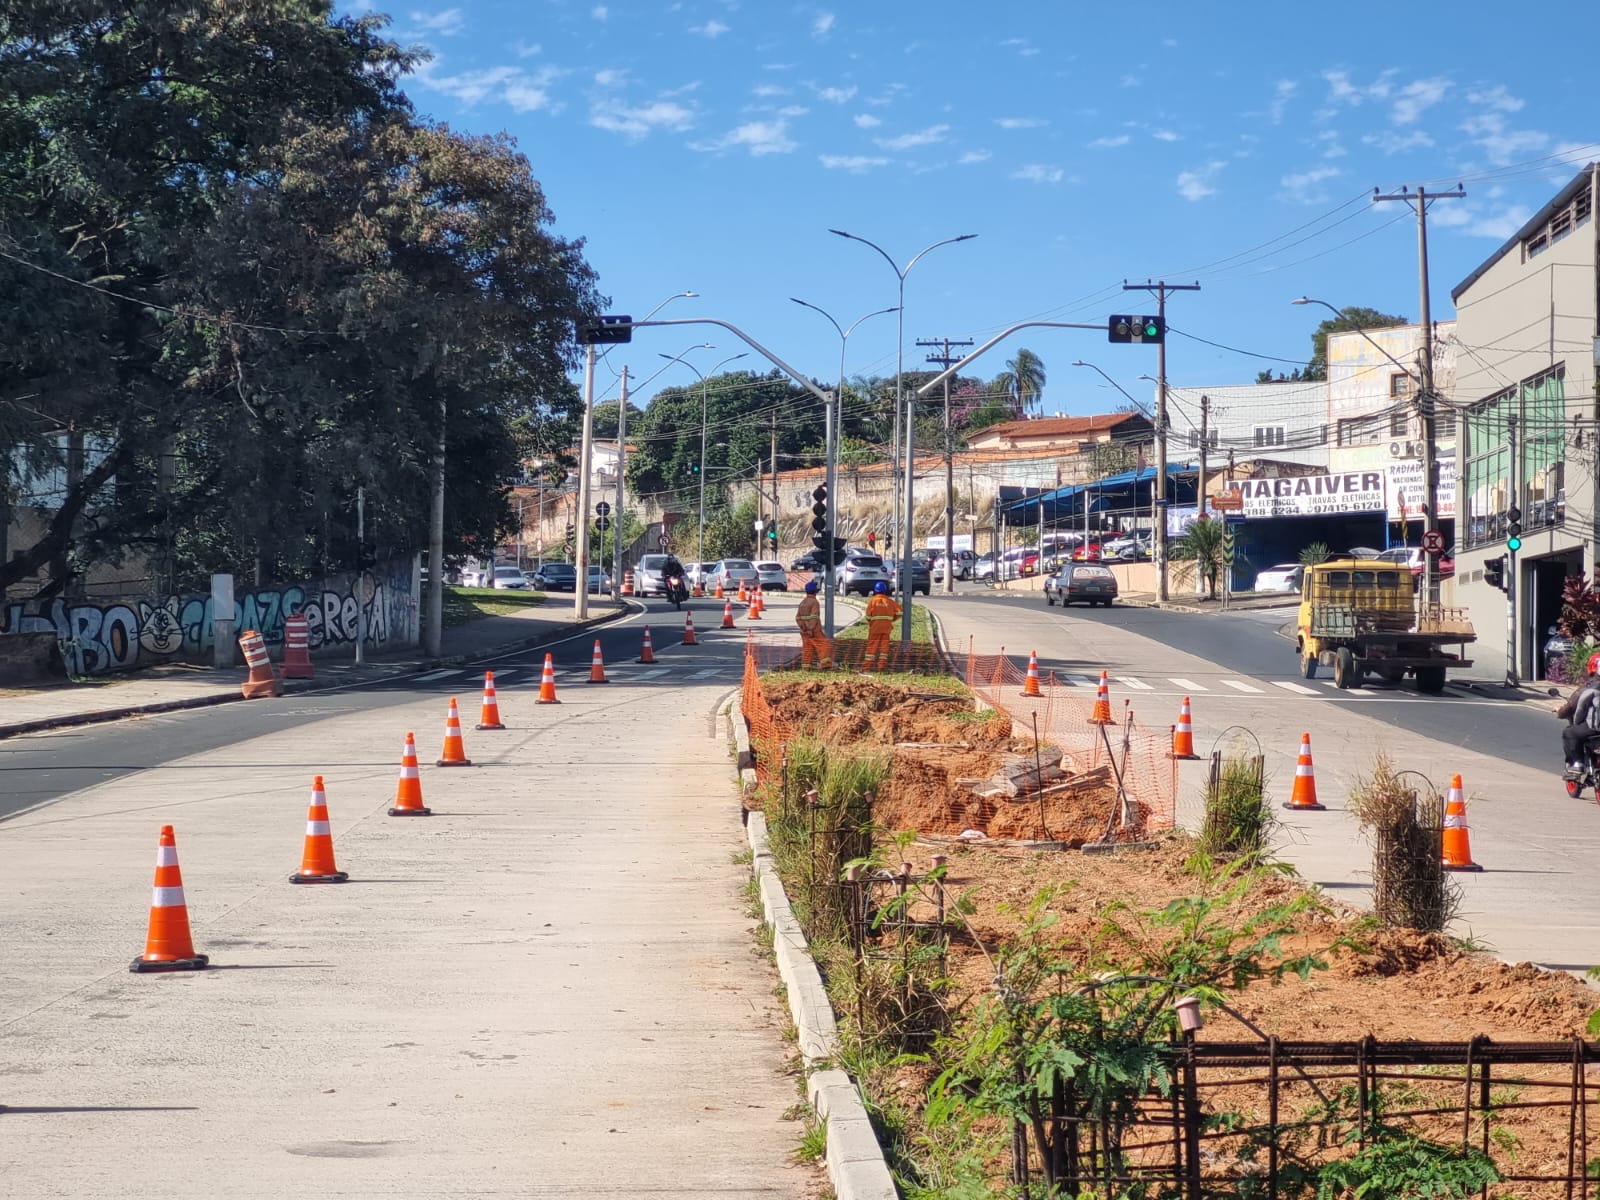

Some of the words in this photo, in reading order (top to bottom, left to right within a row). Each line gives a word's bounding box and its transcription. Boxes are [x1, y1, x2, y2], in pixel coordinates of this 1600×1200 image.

[1228, 472, 1381, 499] MAGAIVER
[1308, 495, 1337, 505] TRAVAS
[1314, 501, 1381, 513] 97415-6120
